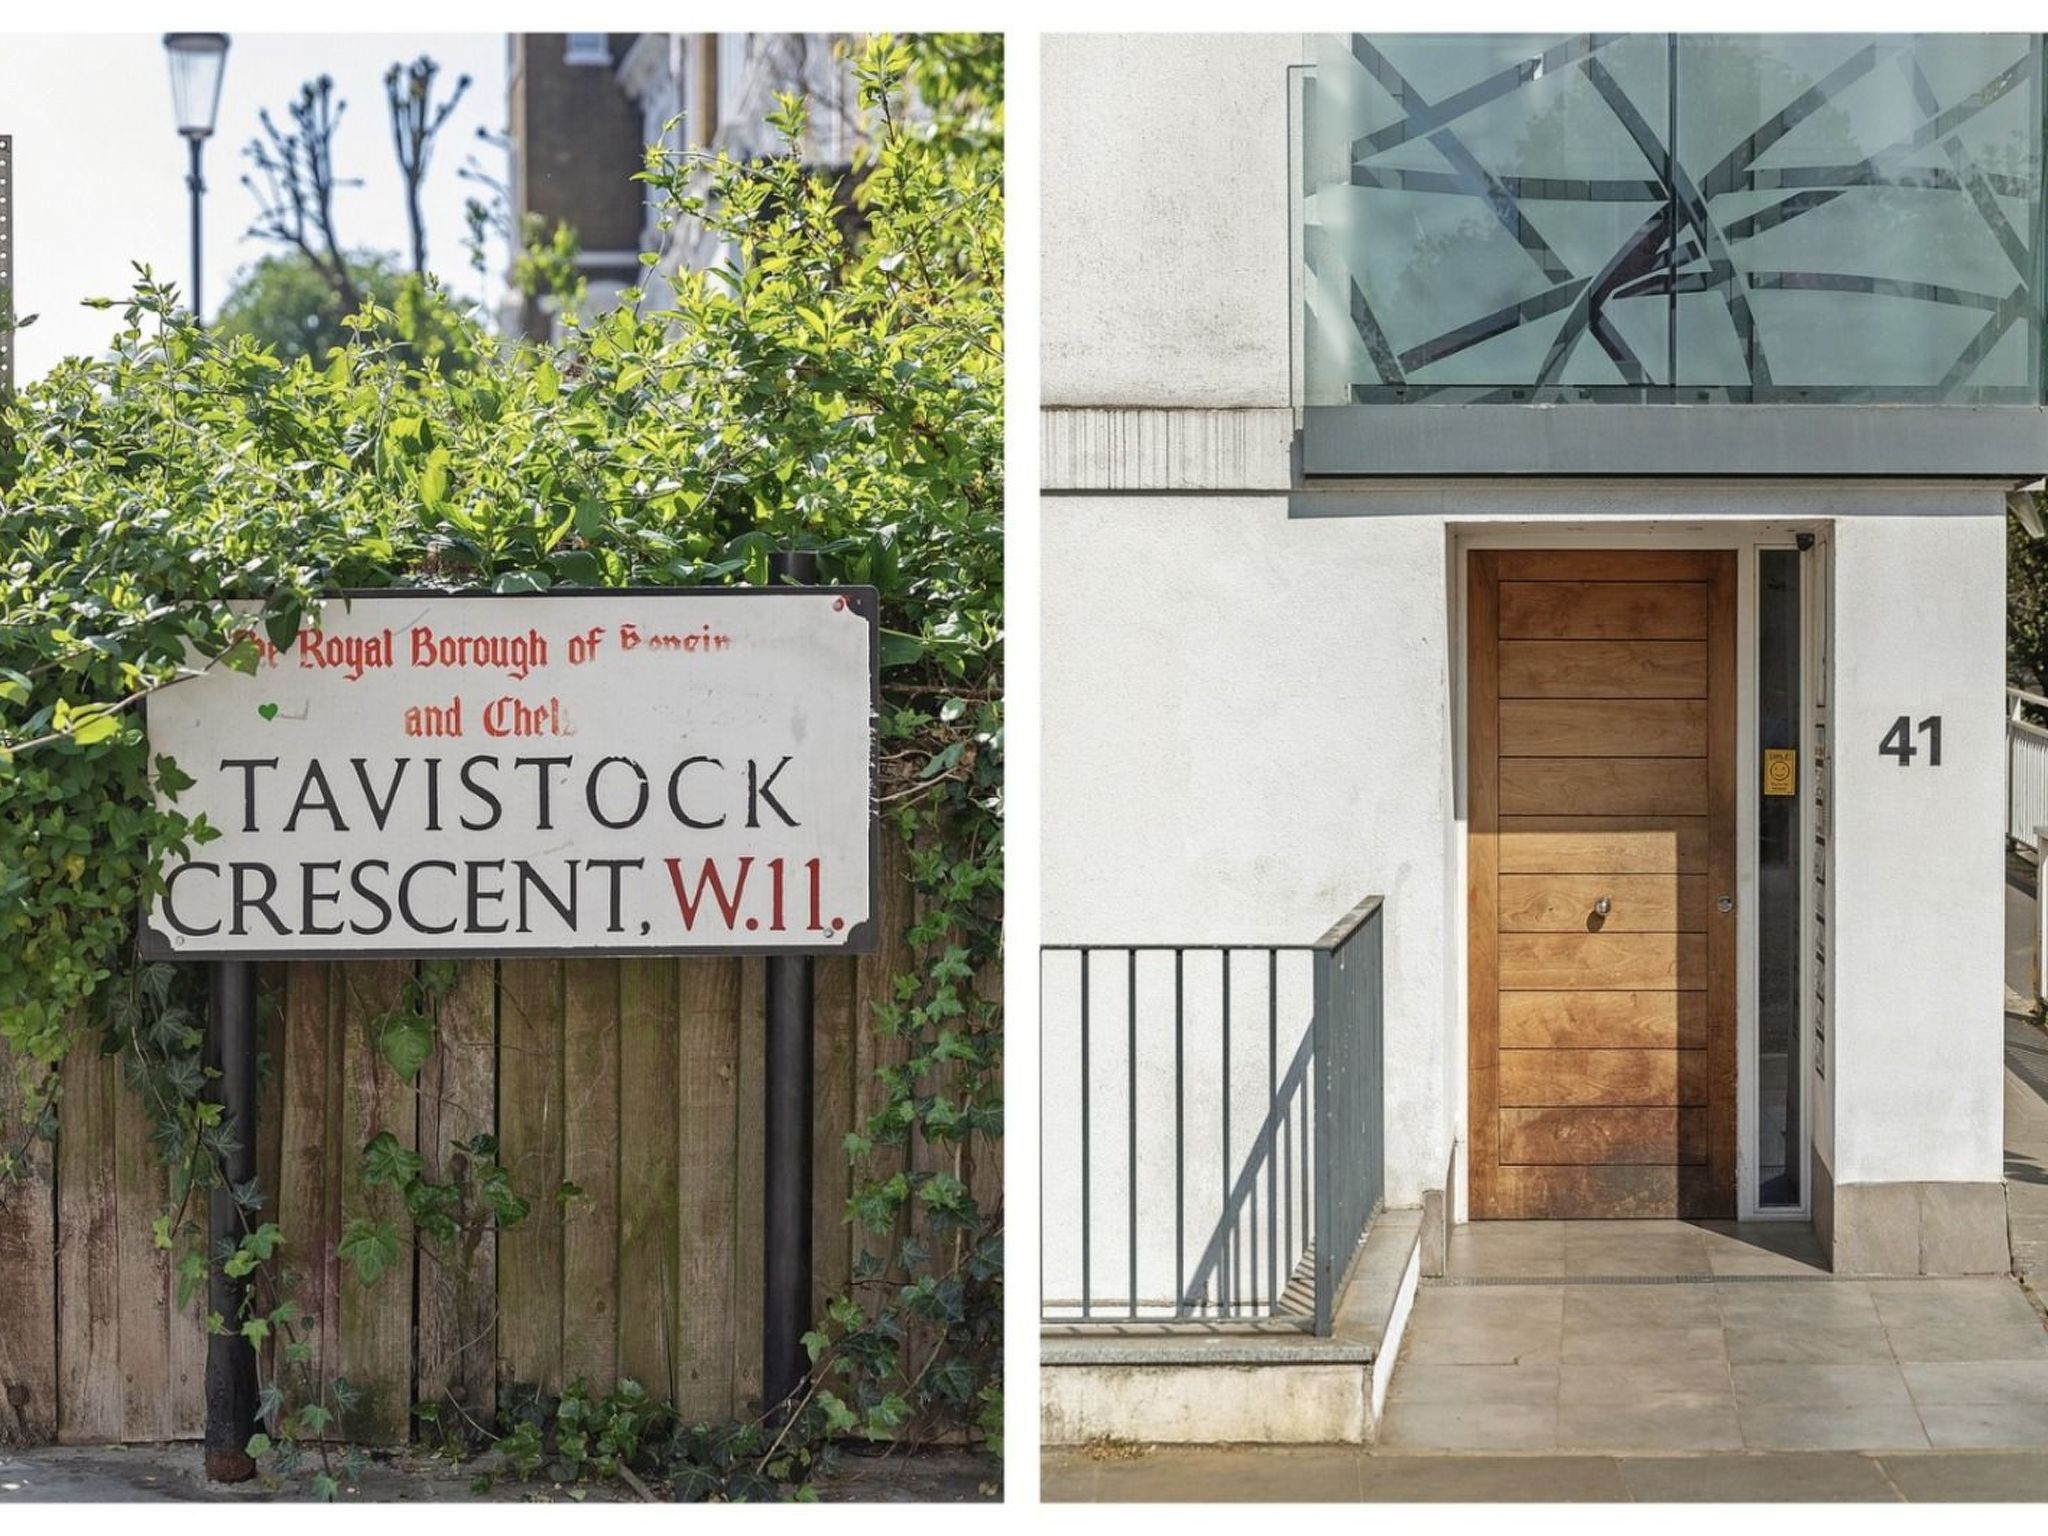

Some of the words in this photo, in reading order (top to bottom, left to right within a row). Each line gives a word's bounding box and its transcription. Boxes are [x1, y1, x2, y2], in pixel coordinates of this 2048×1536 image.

[297, 628, 393, 682] Royal
[411, 626, 548, 681] Borough
[568, 626, 606, 666] of
[404, 696, 463, 737] and
[1879, 715, 1941, 766] 41
[220, 755, 801, 832] TAVISTOCK
[161, 857, 651, 936] CRESCENT,
[664, 857, 844, 931] W.11.
